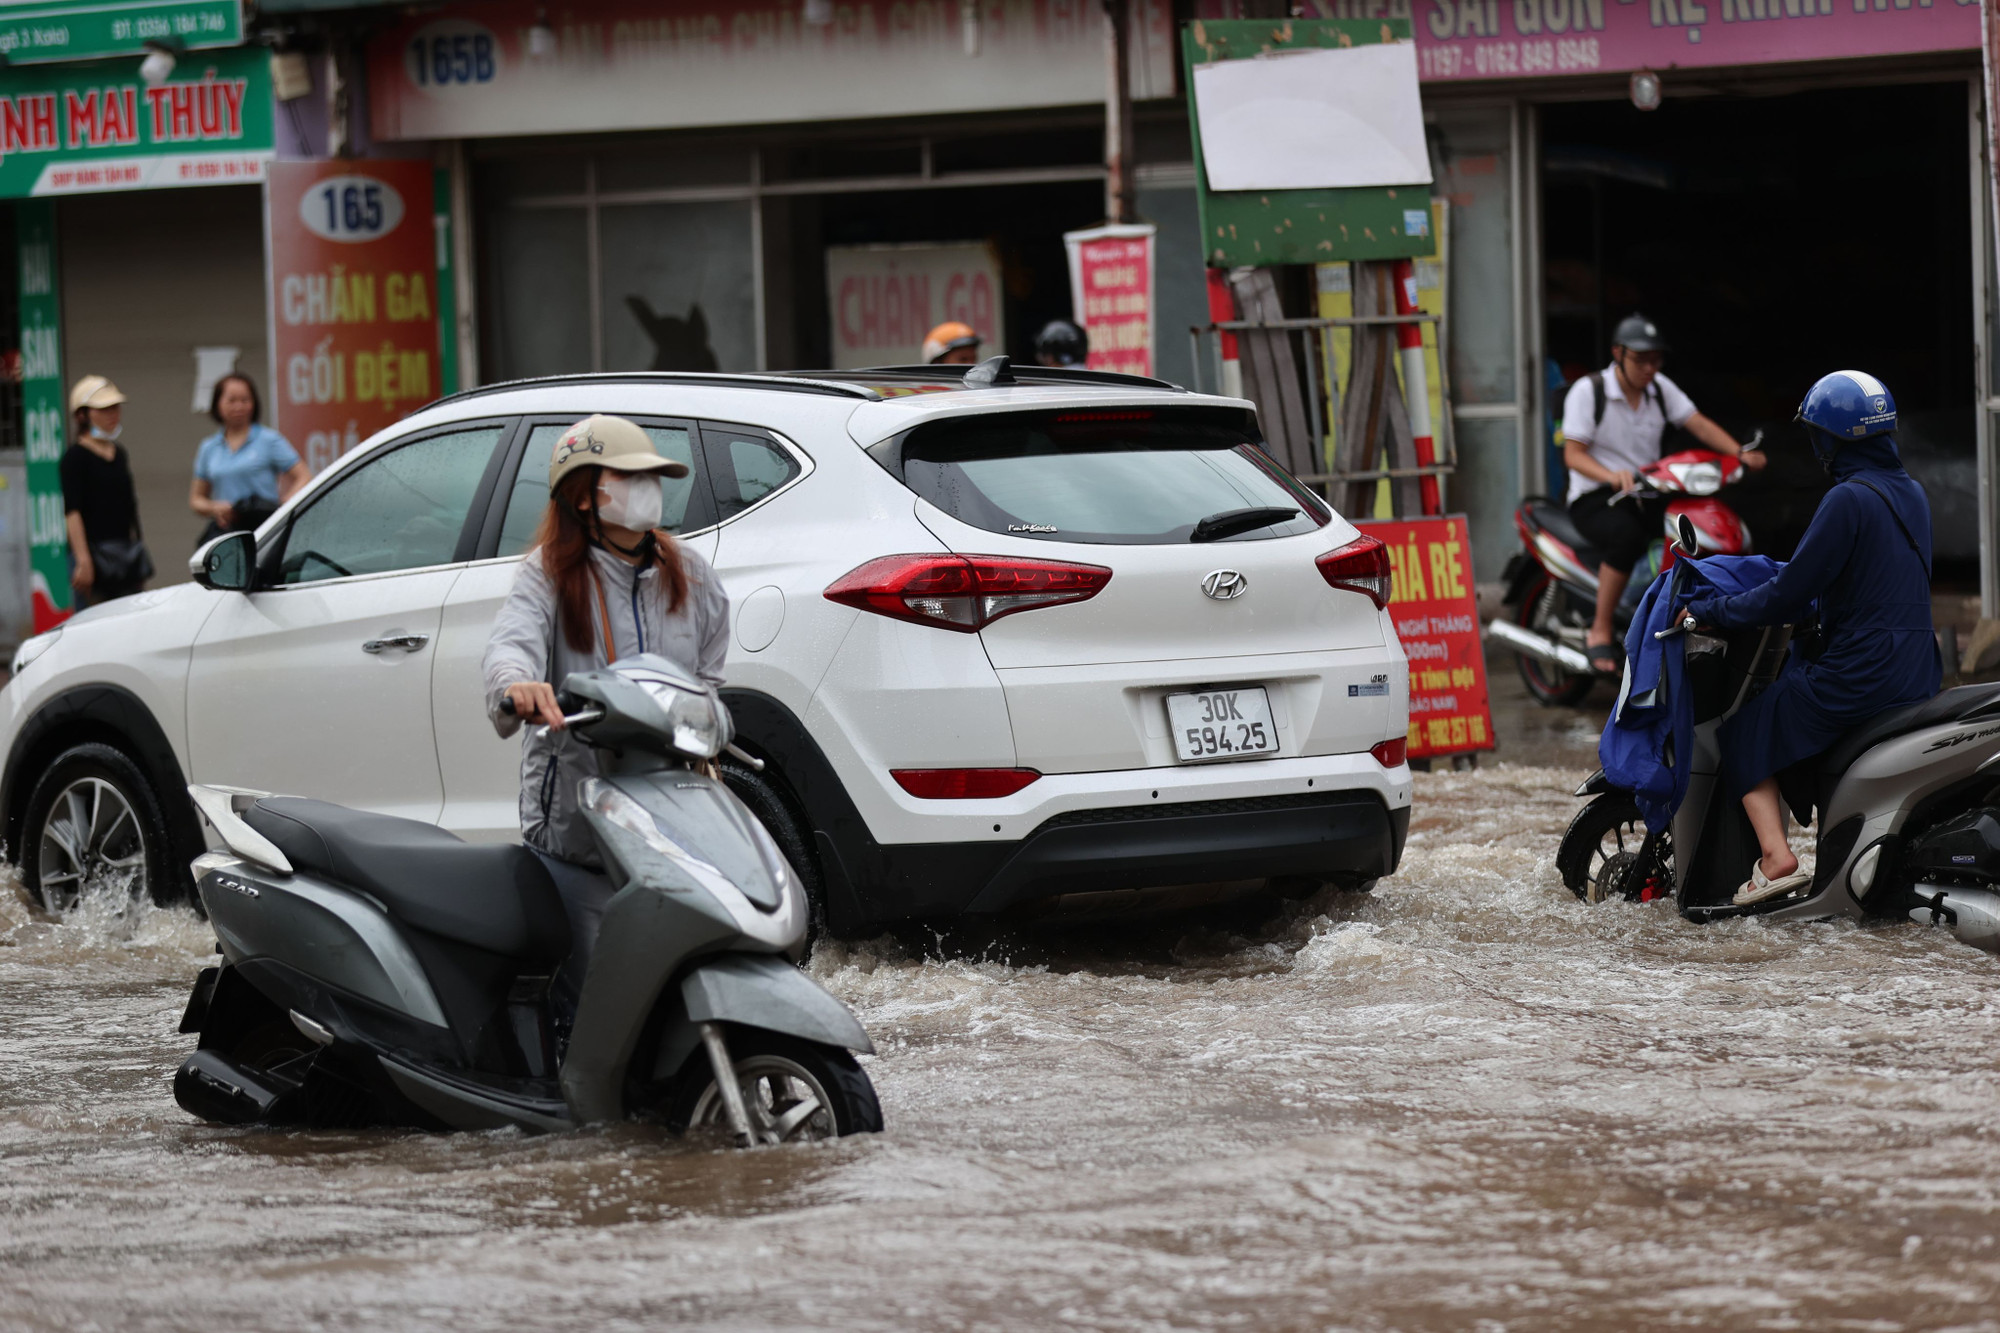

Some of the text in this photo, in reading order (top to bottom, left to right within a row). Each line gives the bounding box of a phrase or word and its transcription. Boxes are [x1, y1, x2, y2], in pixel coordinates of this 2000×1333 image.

[412, 33, 495, 85] 165B
[0, 92, 58, 155] NH
[64, 84, 139, 149] MAI
[323, 184, 384, 232] 165
[281, 267, 431, 325] CHĂN GA
[945, 271, 995, 346] GA
[288, 335, 431, 410] GỐI ĐỆM
[1429, 521, 1467, 599] RẺ
[1198, 692, 1244, 723] 30K
[1186, 722, 1267, 756] 594.25
[216, 877, 260, 898] LEAD
